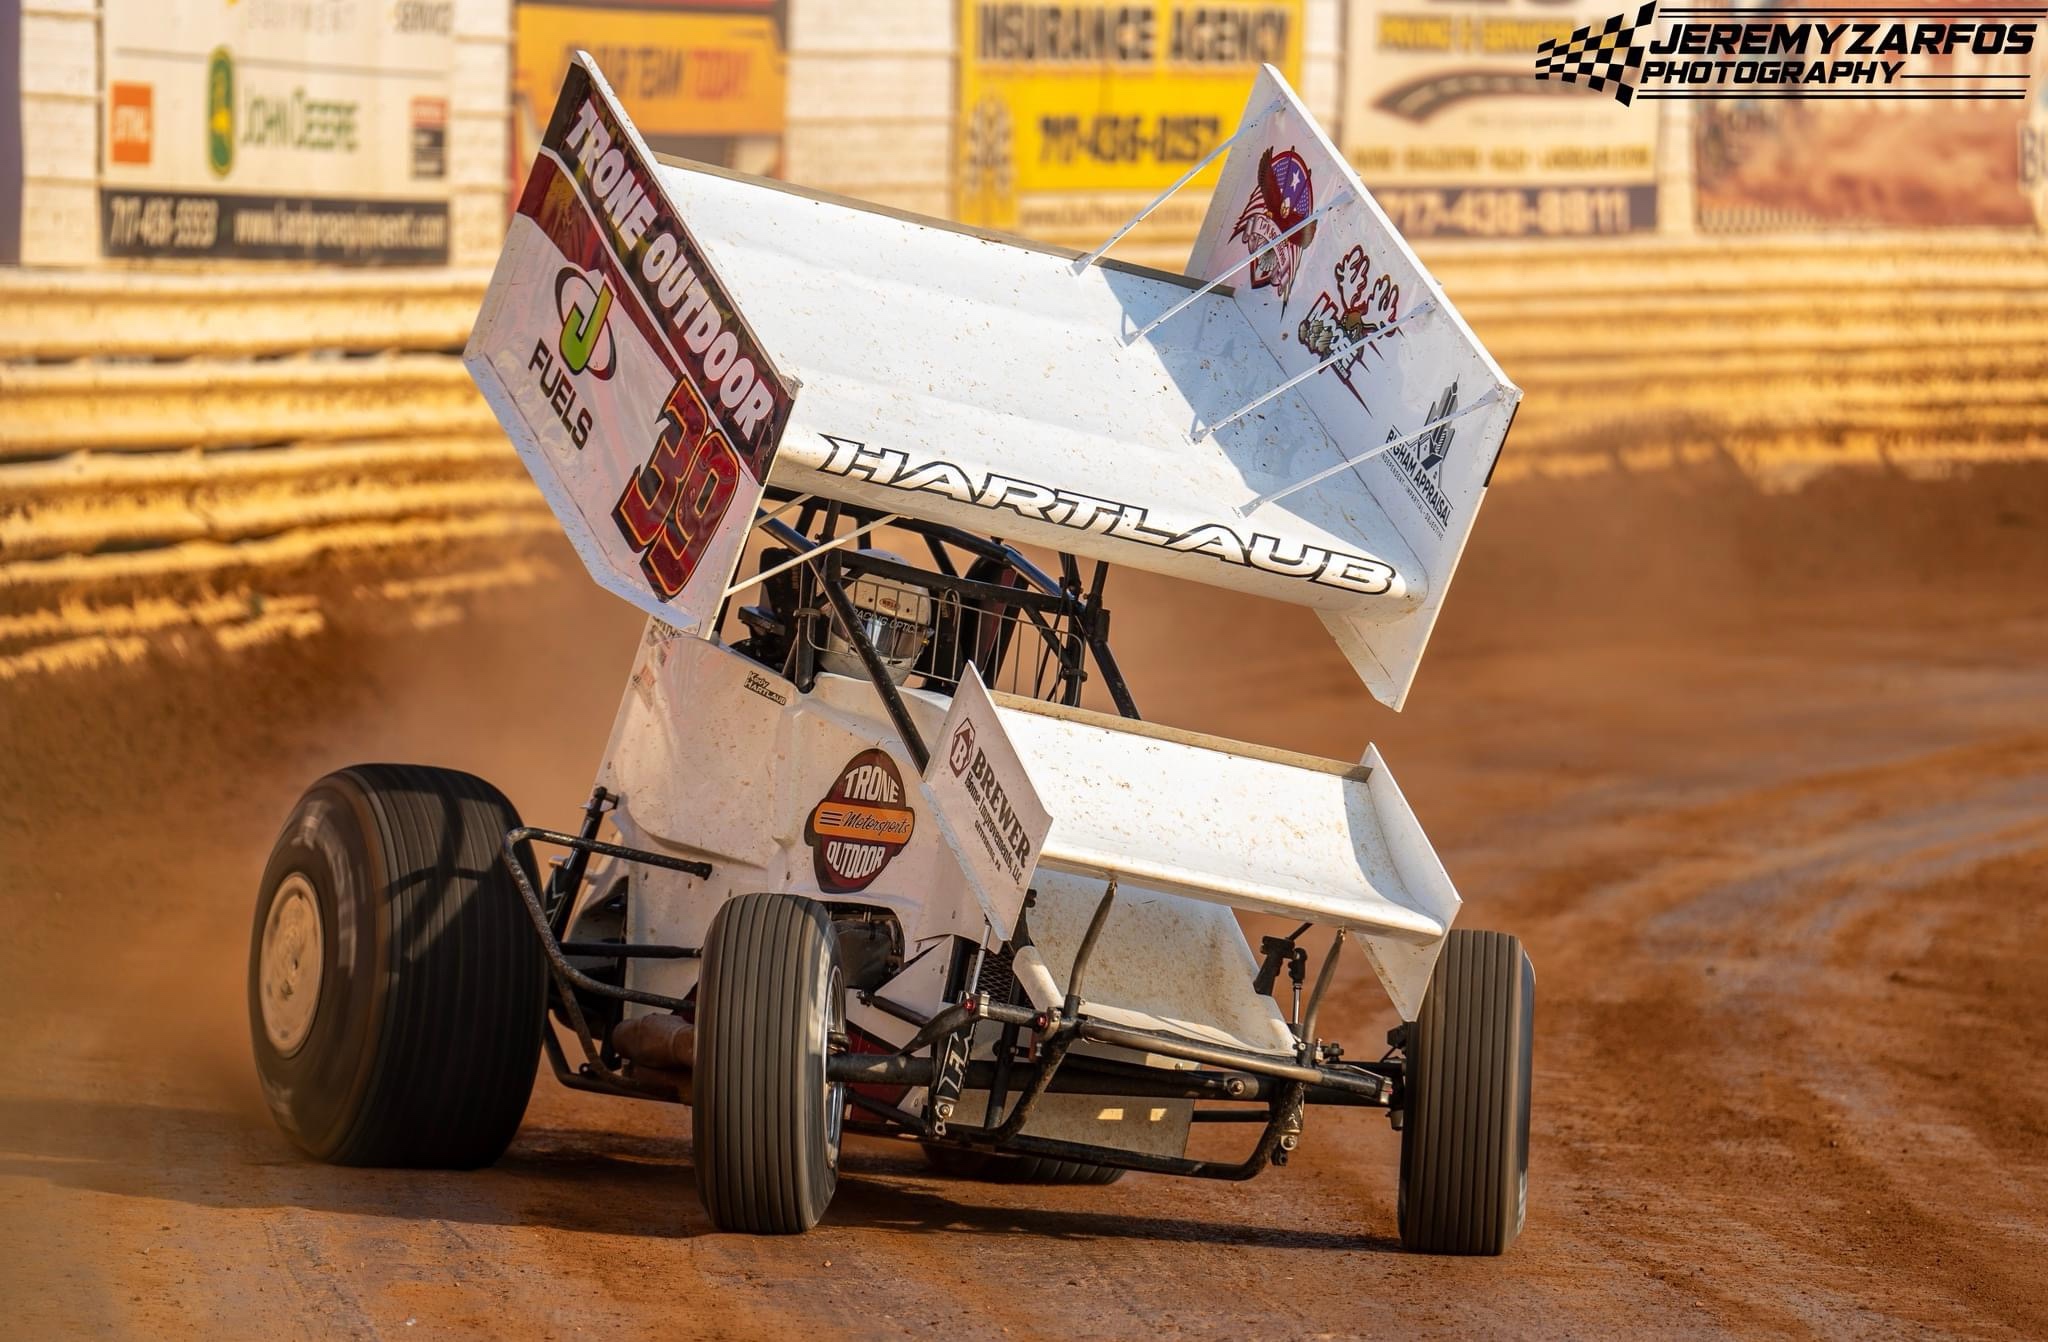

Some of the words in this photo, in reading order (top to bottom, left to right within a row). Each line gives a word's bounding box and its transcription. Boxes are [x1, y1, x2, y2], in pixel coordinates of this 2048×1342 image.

[977, 4, 1156, 60] INSURANCE
[1171, 9, 1289, 62] AGENCY
[566, 99, 658, 250] TRONE
[642, 233, 773, 440] OUTDOOR
[528, 338, 592, 450] FUELS
[818, 433, 1397, 595] HARTLAUB
[1413, 468, 1451, 527] APPRAISAL
[744, 680, 787, 706] HARTLAUB
[844, 765, 899, 803] TRONE
[964, 771, 981, 806] Home
[971, 747, 1030, 868] BREWER
[842, 811, 909, 836] Motorsports
[827, 841, 886, 879] OUTDOOR
